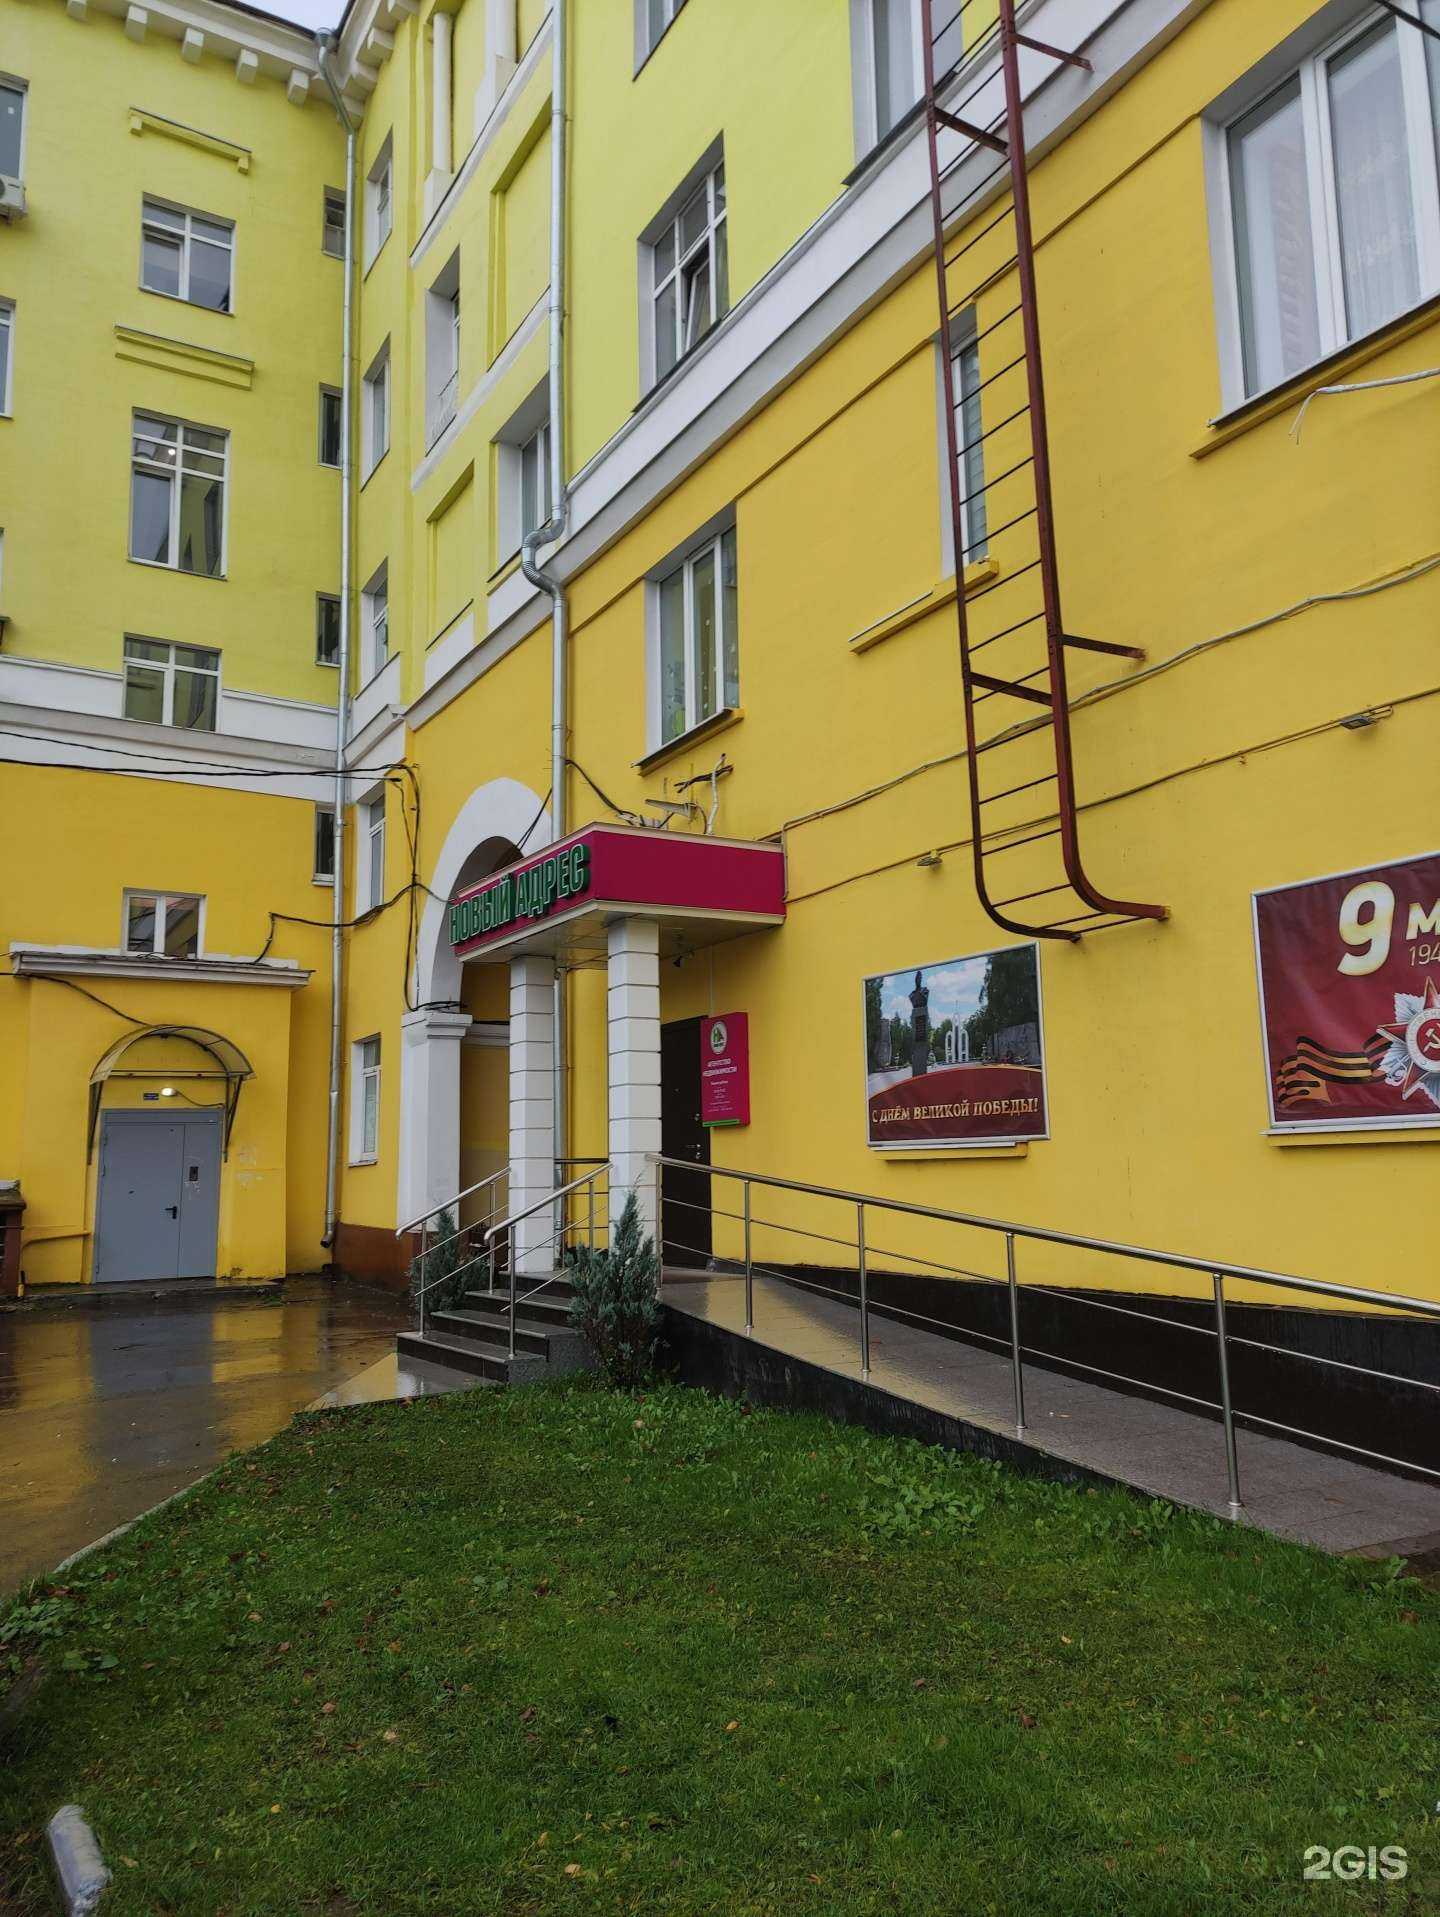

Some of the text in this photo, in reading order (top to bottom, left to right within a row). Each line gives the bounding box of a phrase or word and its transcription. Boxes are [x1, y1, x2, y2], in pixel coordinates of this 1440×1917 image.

[448, 843, 587, 947] НОВЫЙ АДРЕС
[1337, 881, 1396, 976] 9
[872, 1097, 1039, 1124] С ДНЁМ ВЕЛИКОЙ ПОБЕДЫ!
